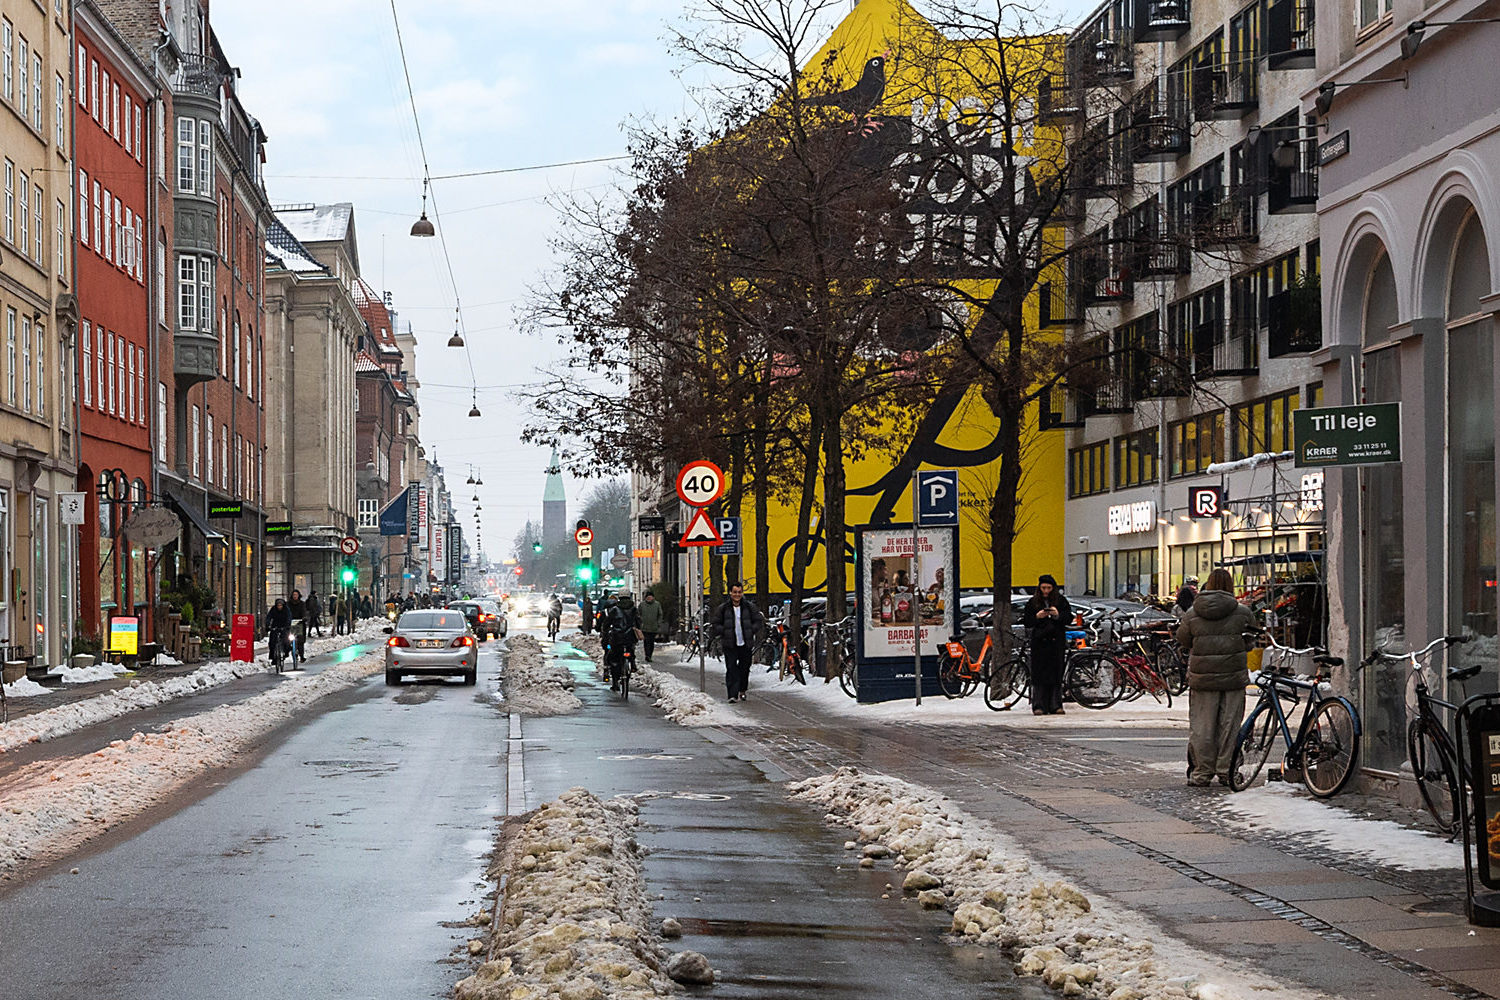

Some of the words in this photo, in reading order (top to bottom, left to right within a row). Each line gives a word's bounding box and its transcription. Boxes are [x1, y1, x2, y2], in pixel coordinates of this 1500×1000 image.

[1311, 414, 1336, 431] Til
[1341, 412, 1377, 432] leje
[1306, 447, 1338, 456] KRAER
[1348, 450, 1392, 458] www.kraer.dk
[684, 475, 714, 493] 40
[931, 484, 947, 506] P
[960, 499, 986, 507] kker
[1197, 491, 1216, 513] R
[410, 482, 419, 535] CINEMATEKET
[720, 521, 733, 538] P
[896, 537, 908, 545] HER
[452, 528, 460, 576] CINEMATEKET
